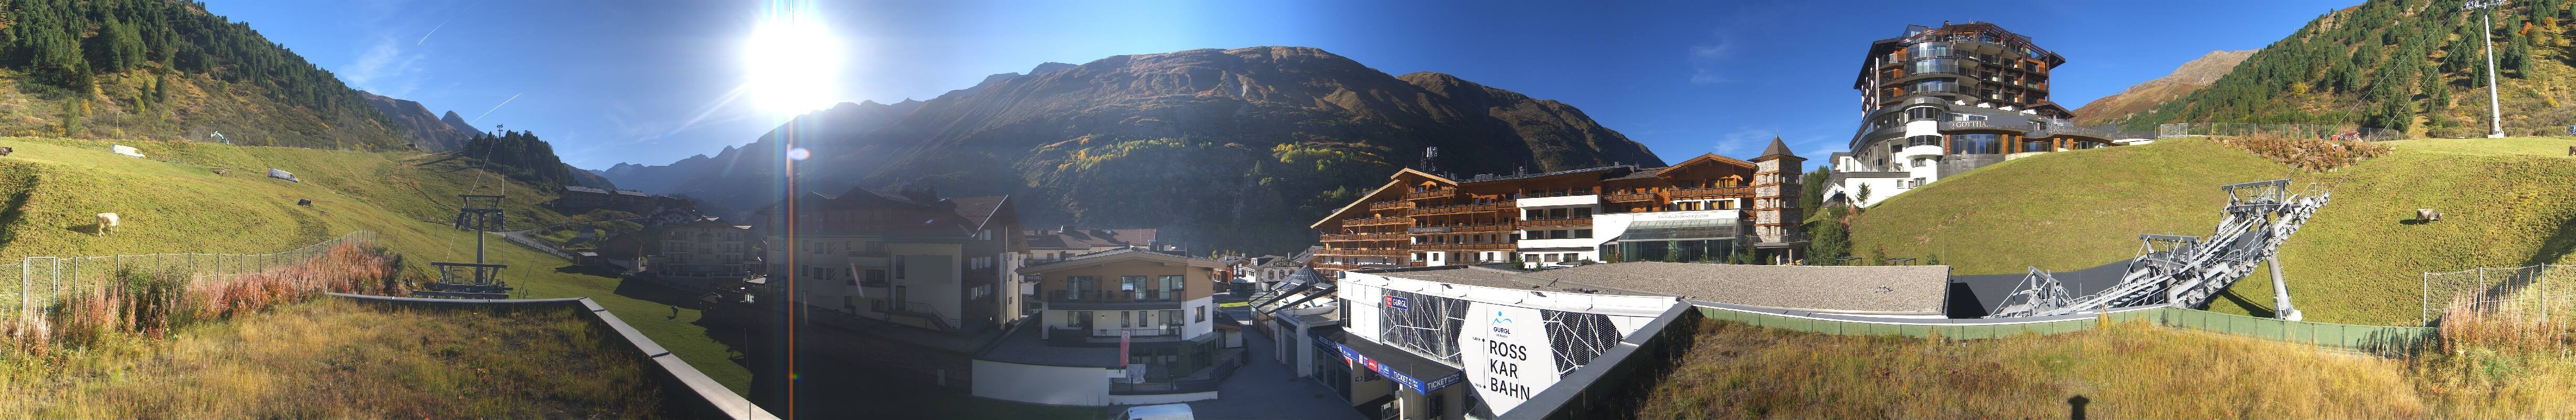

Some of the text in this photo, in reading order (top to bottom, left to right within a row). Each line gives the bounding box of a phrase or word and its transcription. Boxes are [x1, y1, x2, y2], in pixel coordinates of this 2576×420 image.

[1393, 299, 1407, 308] GURGL
[1490, 340, 1526, 361] ROSS
[1490, 359, 1518, 379] KAR
[1393, 371, 1409, 384] TICKET
[1427, 377, 1448, 390] TICKET
[1491, 377, 1530, 401] BAHN
